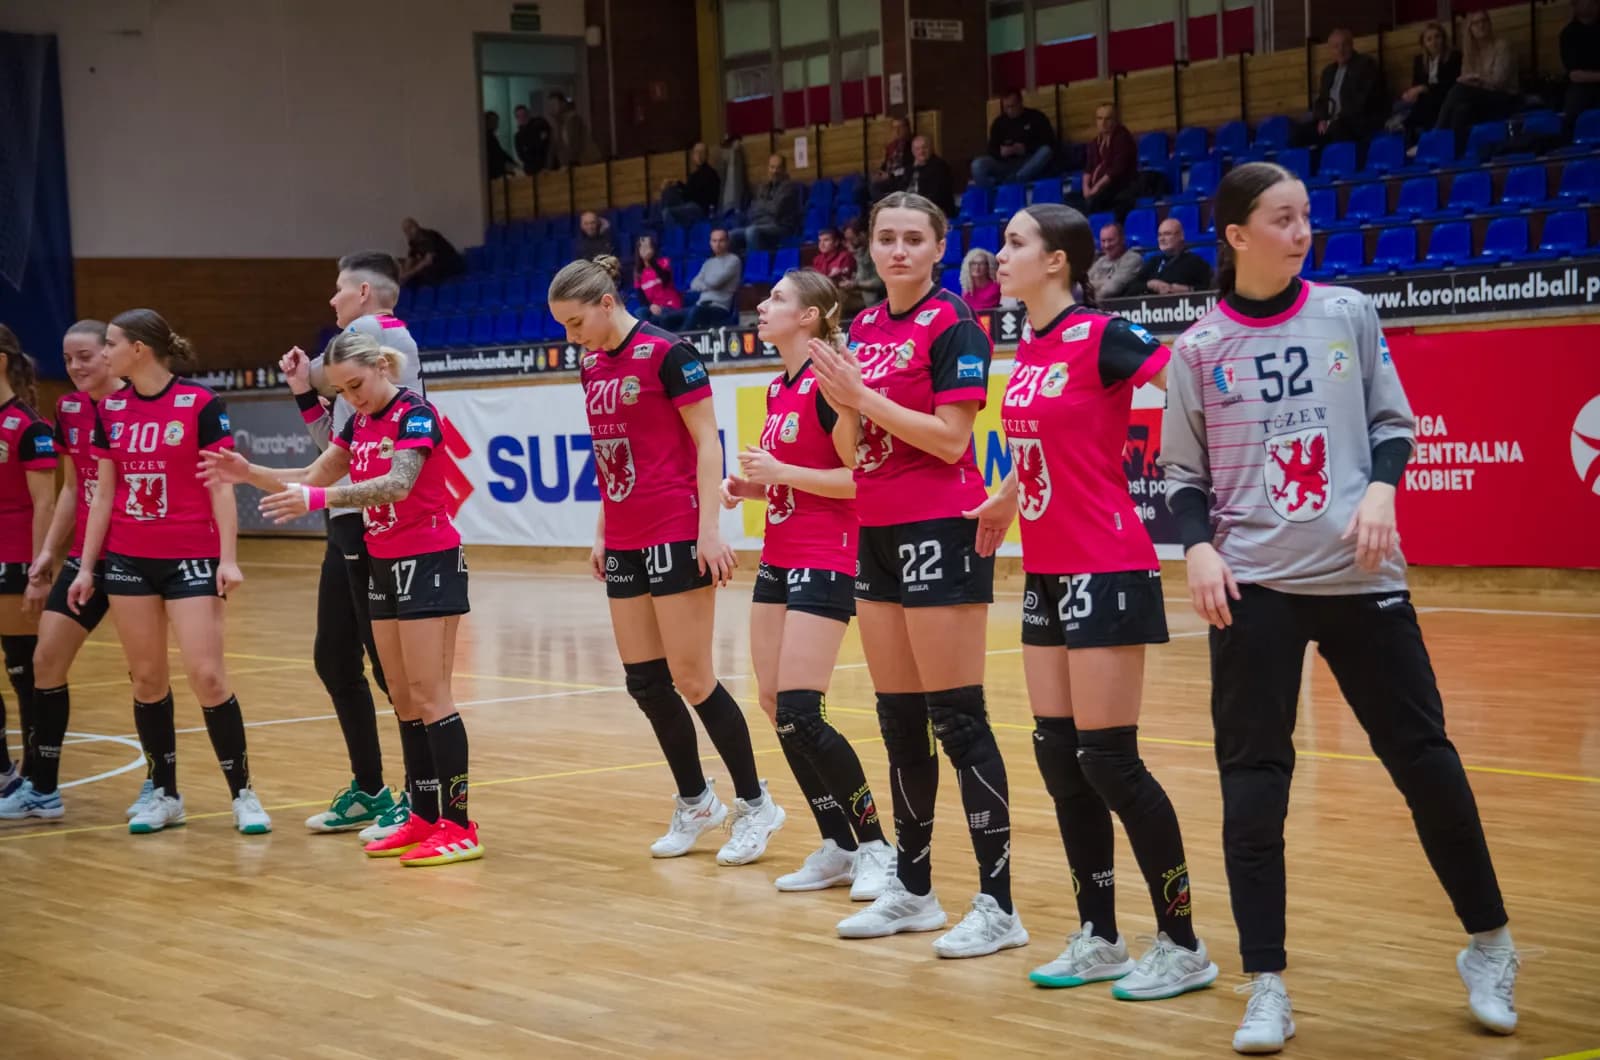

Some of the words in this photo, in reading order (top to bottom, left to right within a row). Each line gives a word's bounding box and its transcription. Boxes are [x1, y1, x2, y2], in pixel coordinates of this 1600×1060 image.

[1372, 268, 1600, 308] ww.koronahandball.p
[1004, 364, 1046, 408] 23
[1254, 346, 1314, 403] 52
[590, 378, 619, 416] 20
[127, 422, 160, 453] 10
[761, 412, 783, 450] 21
[1259, 406, 1328, 434] TCZEW
[1414, 414, 1449, 437] IGA
[121, 460, 168, 471] TCZEW
[1404, 468, 1476, 491] KOBIET
[177, 559, 212, 581] 10
[391, 559, 417, 595] 17
[606, 574, 635, 583] DOMY
[898, 539, 943, 584] 22
[1057, 573, 1093, 621] 23
